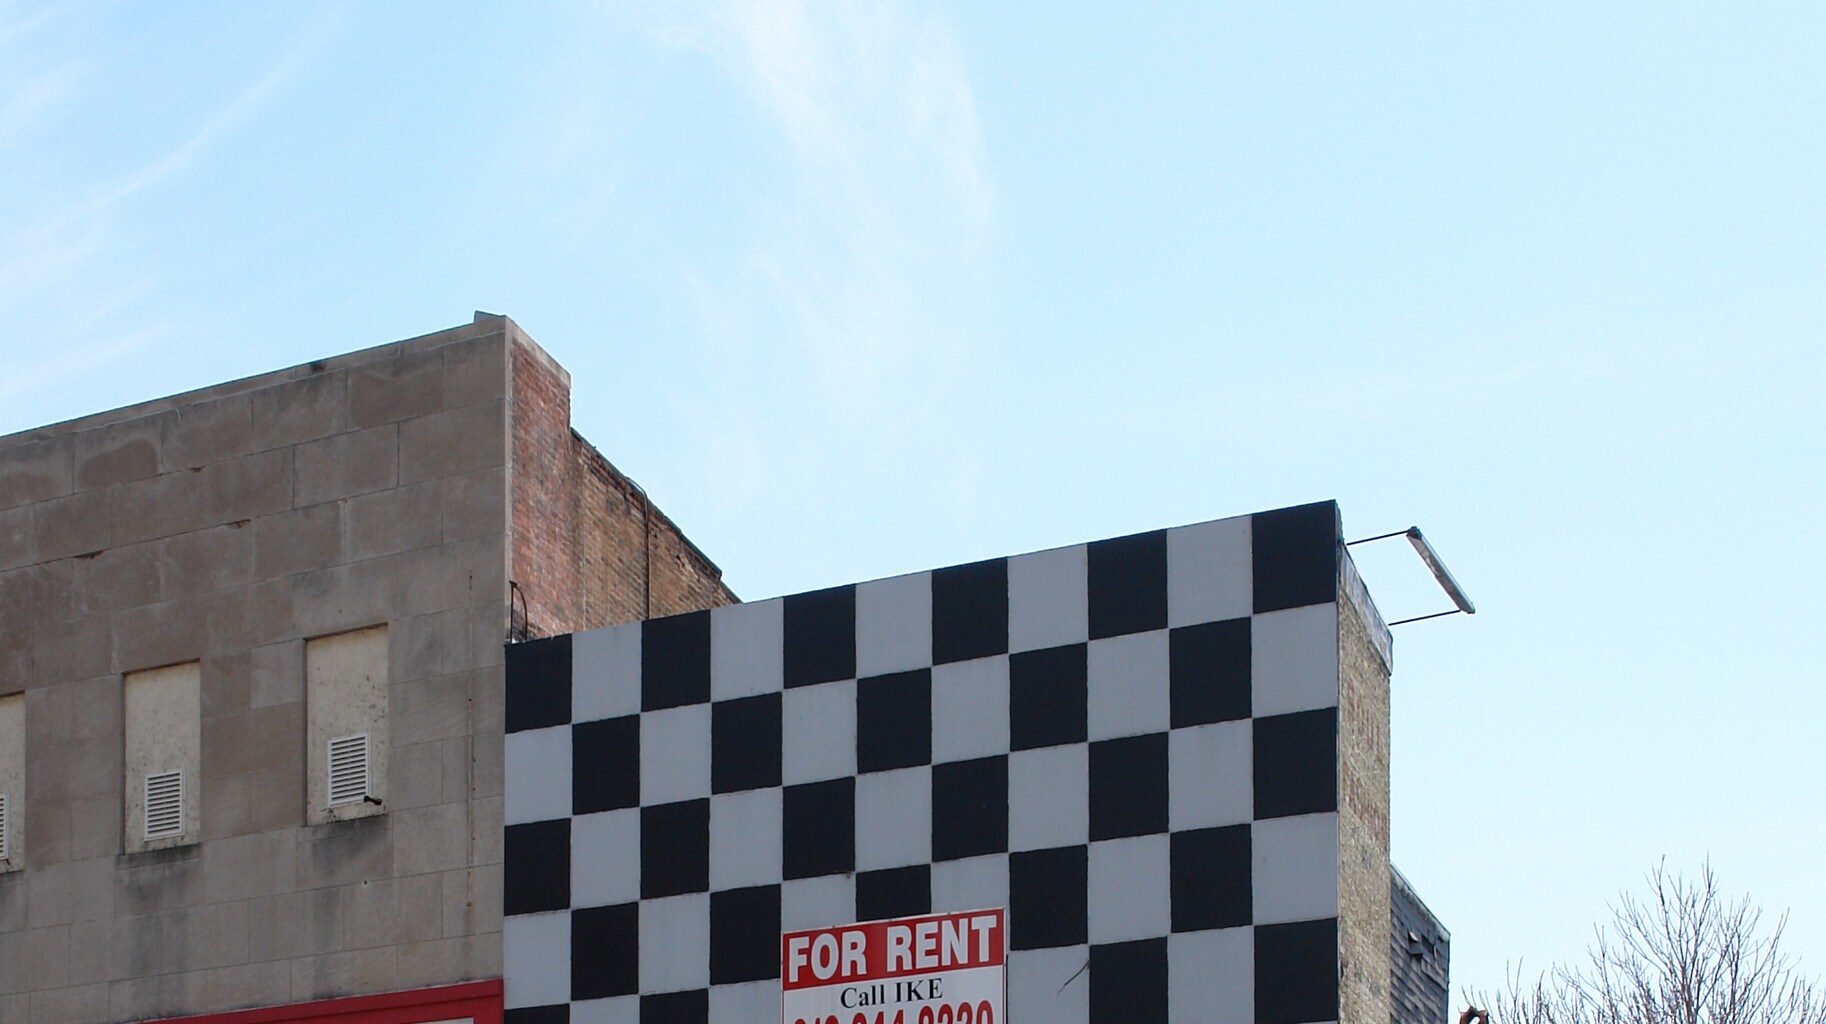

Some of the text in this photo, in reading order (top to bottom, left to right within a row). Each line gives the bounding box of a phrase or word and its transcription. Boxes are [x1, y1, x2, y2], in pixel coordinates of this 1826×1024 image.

[788, 915, 997, 983] FOR RENT
[840, 977, 943, 1009] Call IKE
